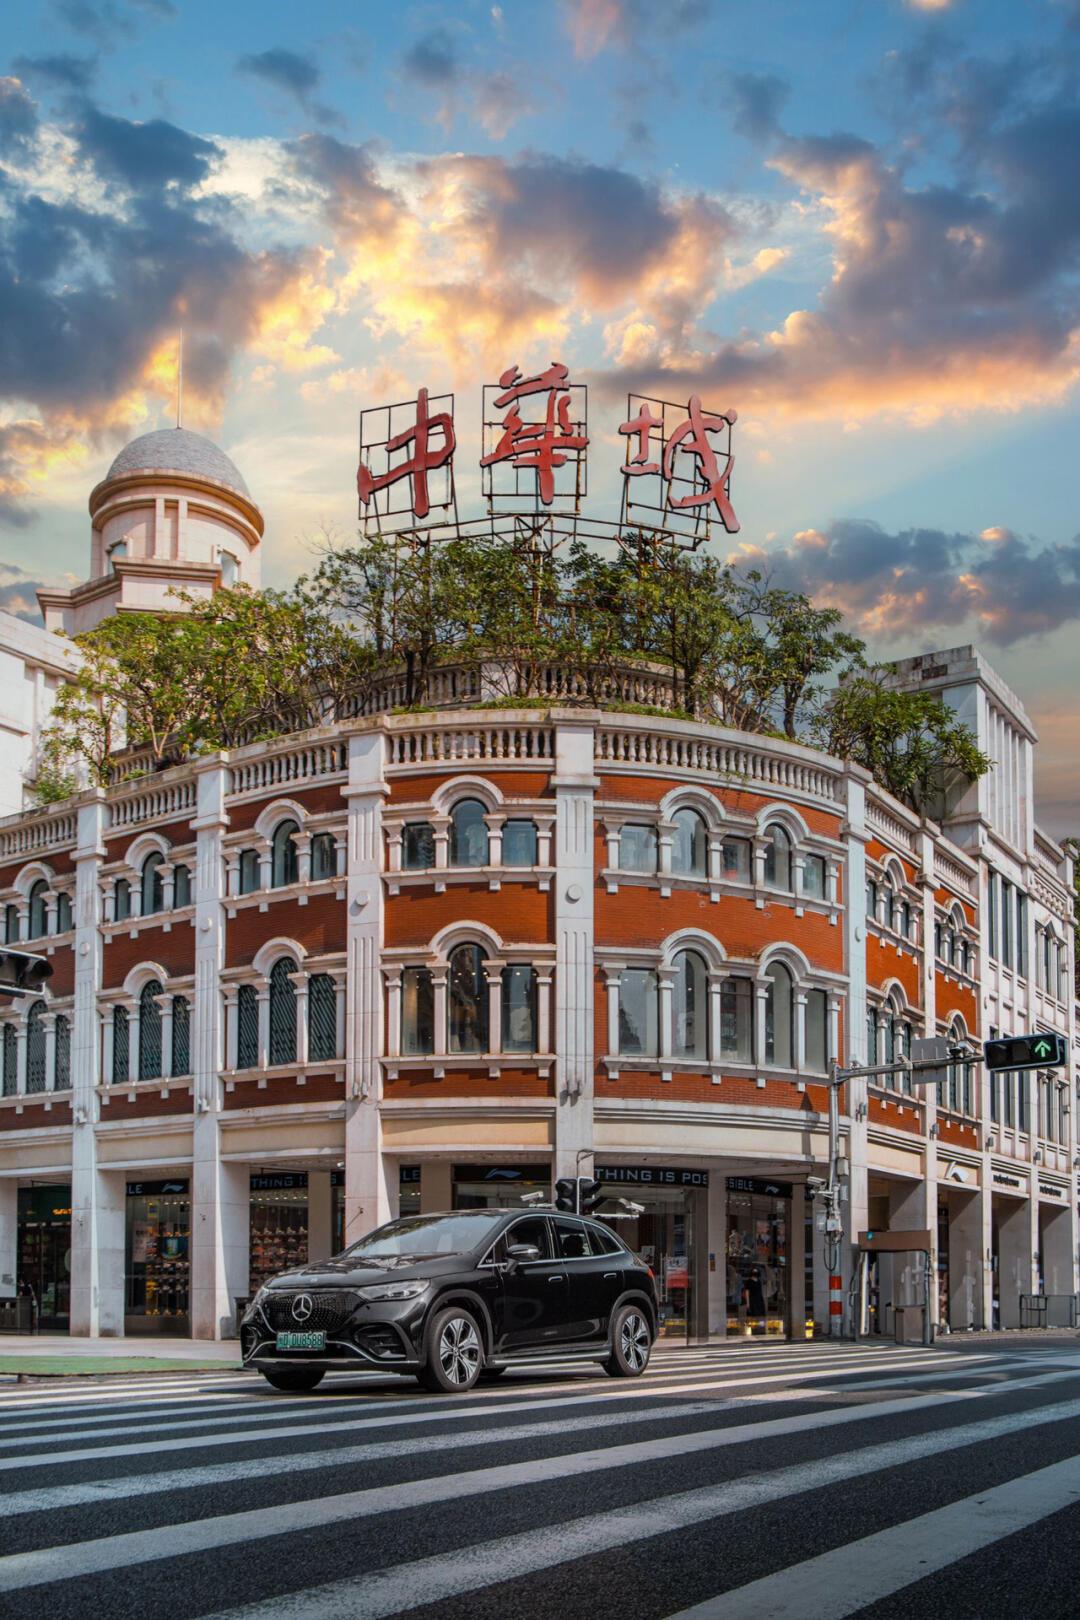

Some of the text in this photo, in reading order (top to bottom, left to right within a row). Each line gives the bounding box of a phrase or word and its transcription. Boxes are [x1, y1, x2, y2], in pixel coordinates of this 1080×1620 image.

[402, 1169, 420, 1181] LE
[594, 1168, 652, 1181] THING
[660, 1171, 675, 1183] IS
[128, 1184, 143, 1195] LE
[727, 1177, 755, 1191] SIBLE
